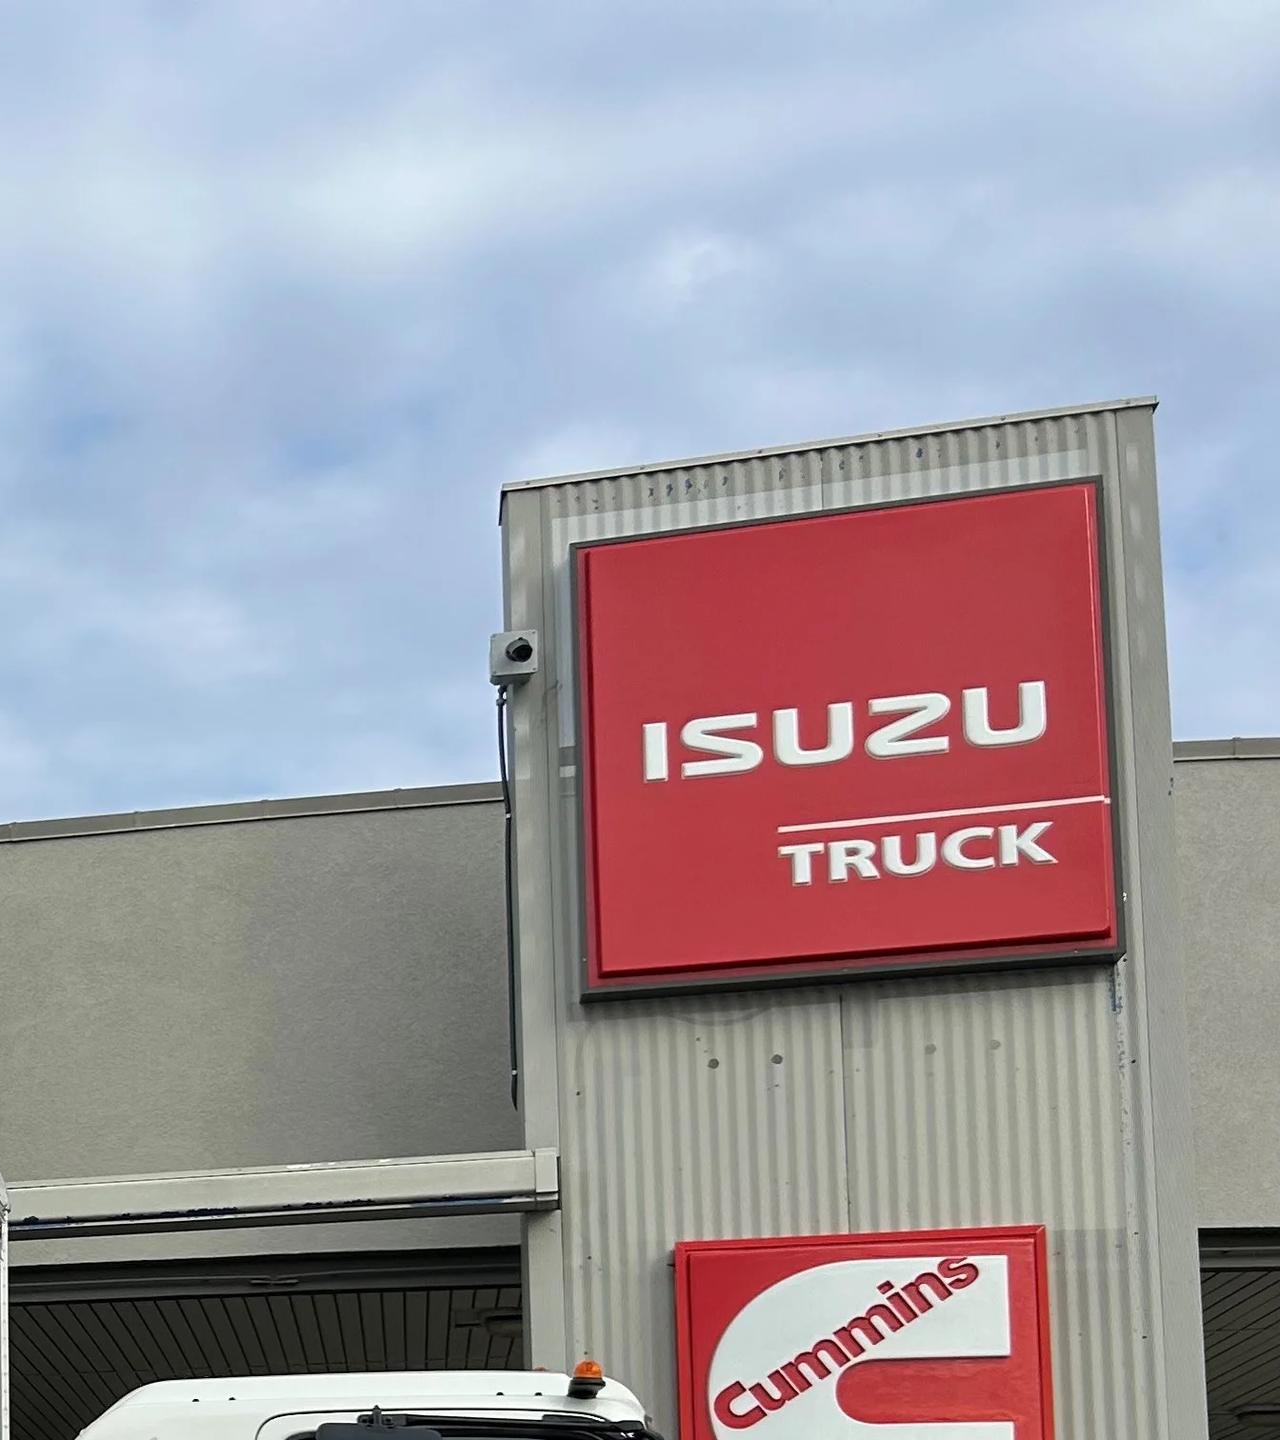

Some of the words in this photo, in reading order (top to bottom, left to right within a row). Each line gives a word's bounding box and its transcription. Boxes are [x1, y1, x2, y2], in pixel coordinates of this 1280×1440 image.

[643, 680, 1047, 783] ISUZU
[778, 821, 1057, 886] TRUCK
[713, 1255, 981, 1431] Cummins
